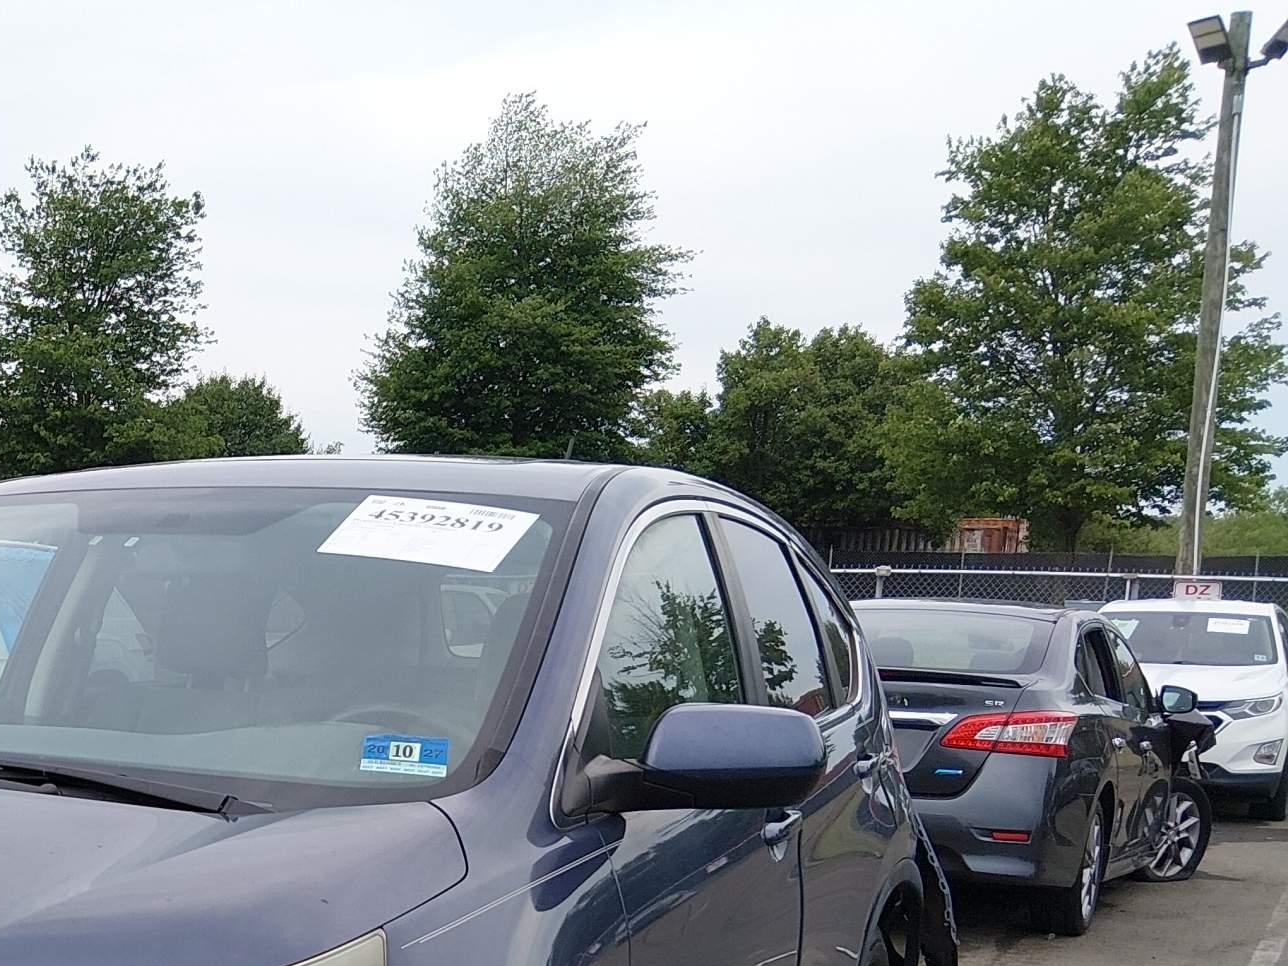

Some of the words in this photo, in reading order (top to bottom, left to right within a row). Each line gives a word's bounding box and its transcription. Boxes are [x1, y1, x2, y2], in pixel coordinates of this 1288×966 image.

[368, 508, 504, 533] 45392819
[1185, 584, 1211, 596] DZ
[367, 744, 386, 754] 20
[391, 744, 414, 759] 10
[423, 748, 444, 760] 27
